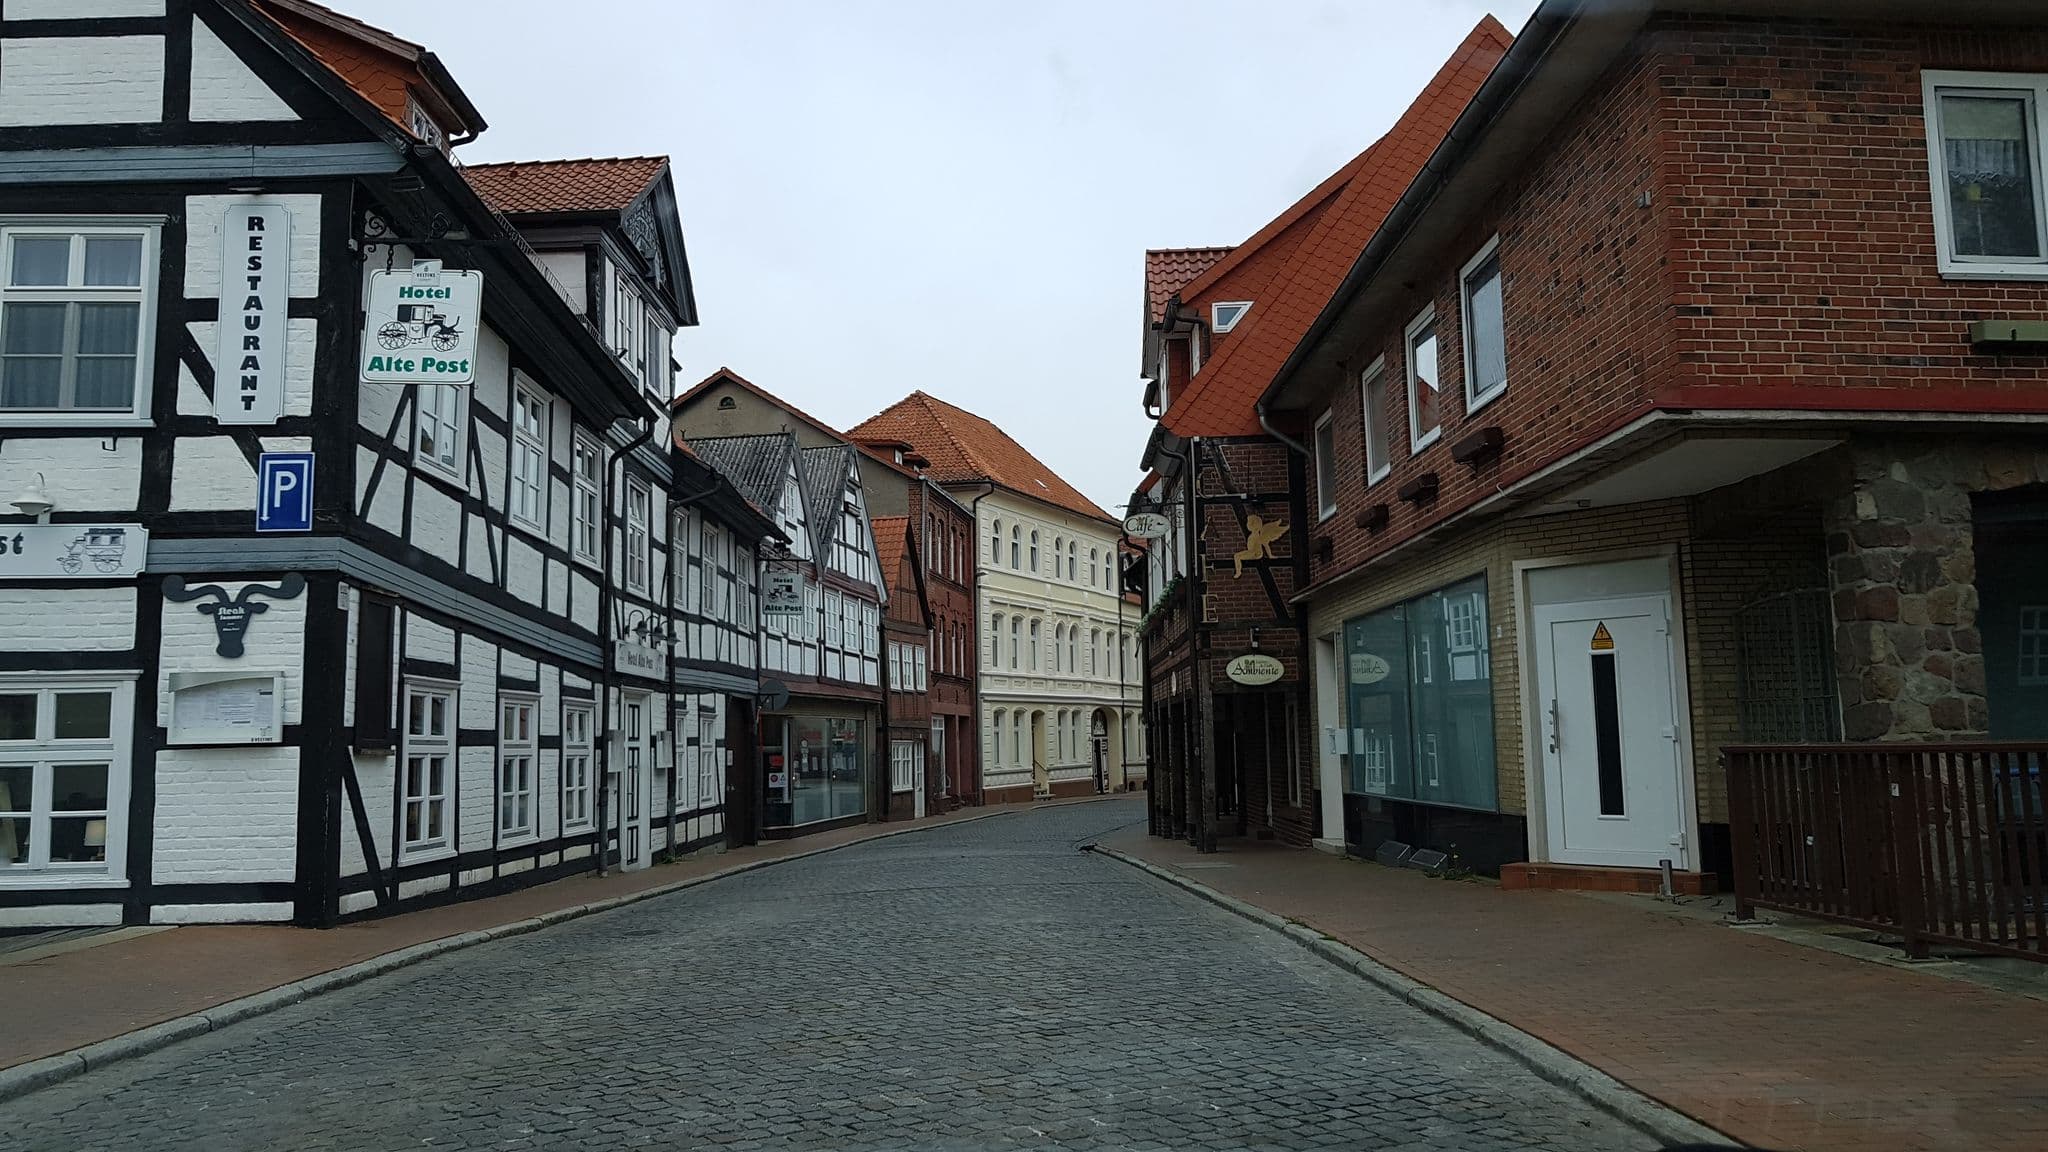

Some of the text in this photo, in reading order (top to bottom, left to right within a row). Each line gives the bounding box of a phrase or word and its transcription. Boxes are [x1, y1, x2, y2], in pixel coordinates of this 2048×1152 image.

[399, 286, 451, 299] Hotel
[240, 216, 265, 411] RESTAURANT
[368, 356, 469, 373] Alte Post
[274, 470, 297, 508] P
[1126, 515, 1153, 536] Café
[218, 606, 245, 615] Steak
[1232, 661, 1279, 676] Ambiente
